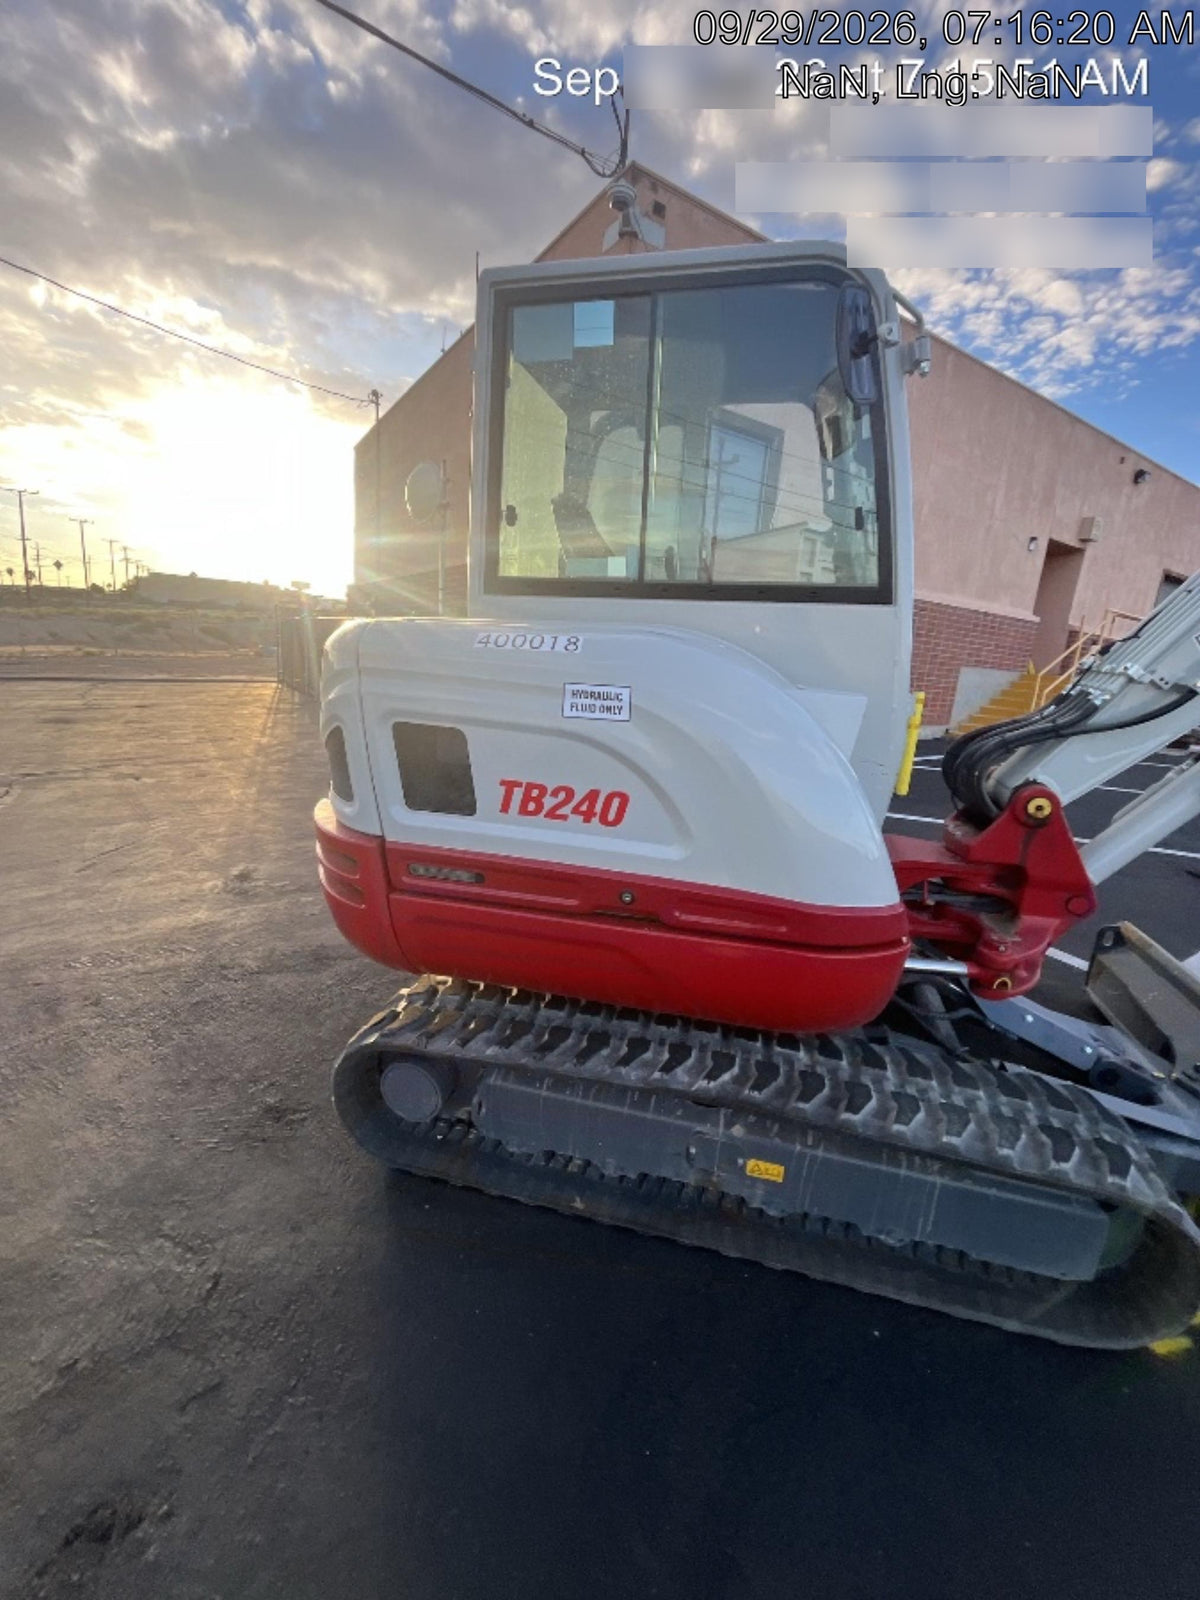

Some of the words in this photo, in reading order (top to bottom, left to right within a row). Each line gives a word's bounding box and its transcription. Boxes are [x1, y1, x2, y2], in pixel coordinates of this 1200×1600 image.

[476, 633, 580, 652] 400018
[571, 689, 624, 703] HYDRAULIC
[570, 702, 597, 714] FLUID
[599, 704, 624, 716] ONLY
[498, 779, 630, 827] TB240
